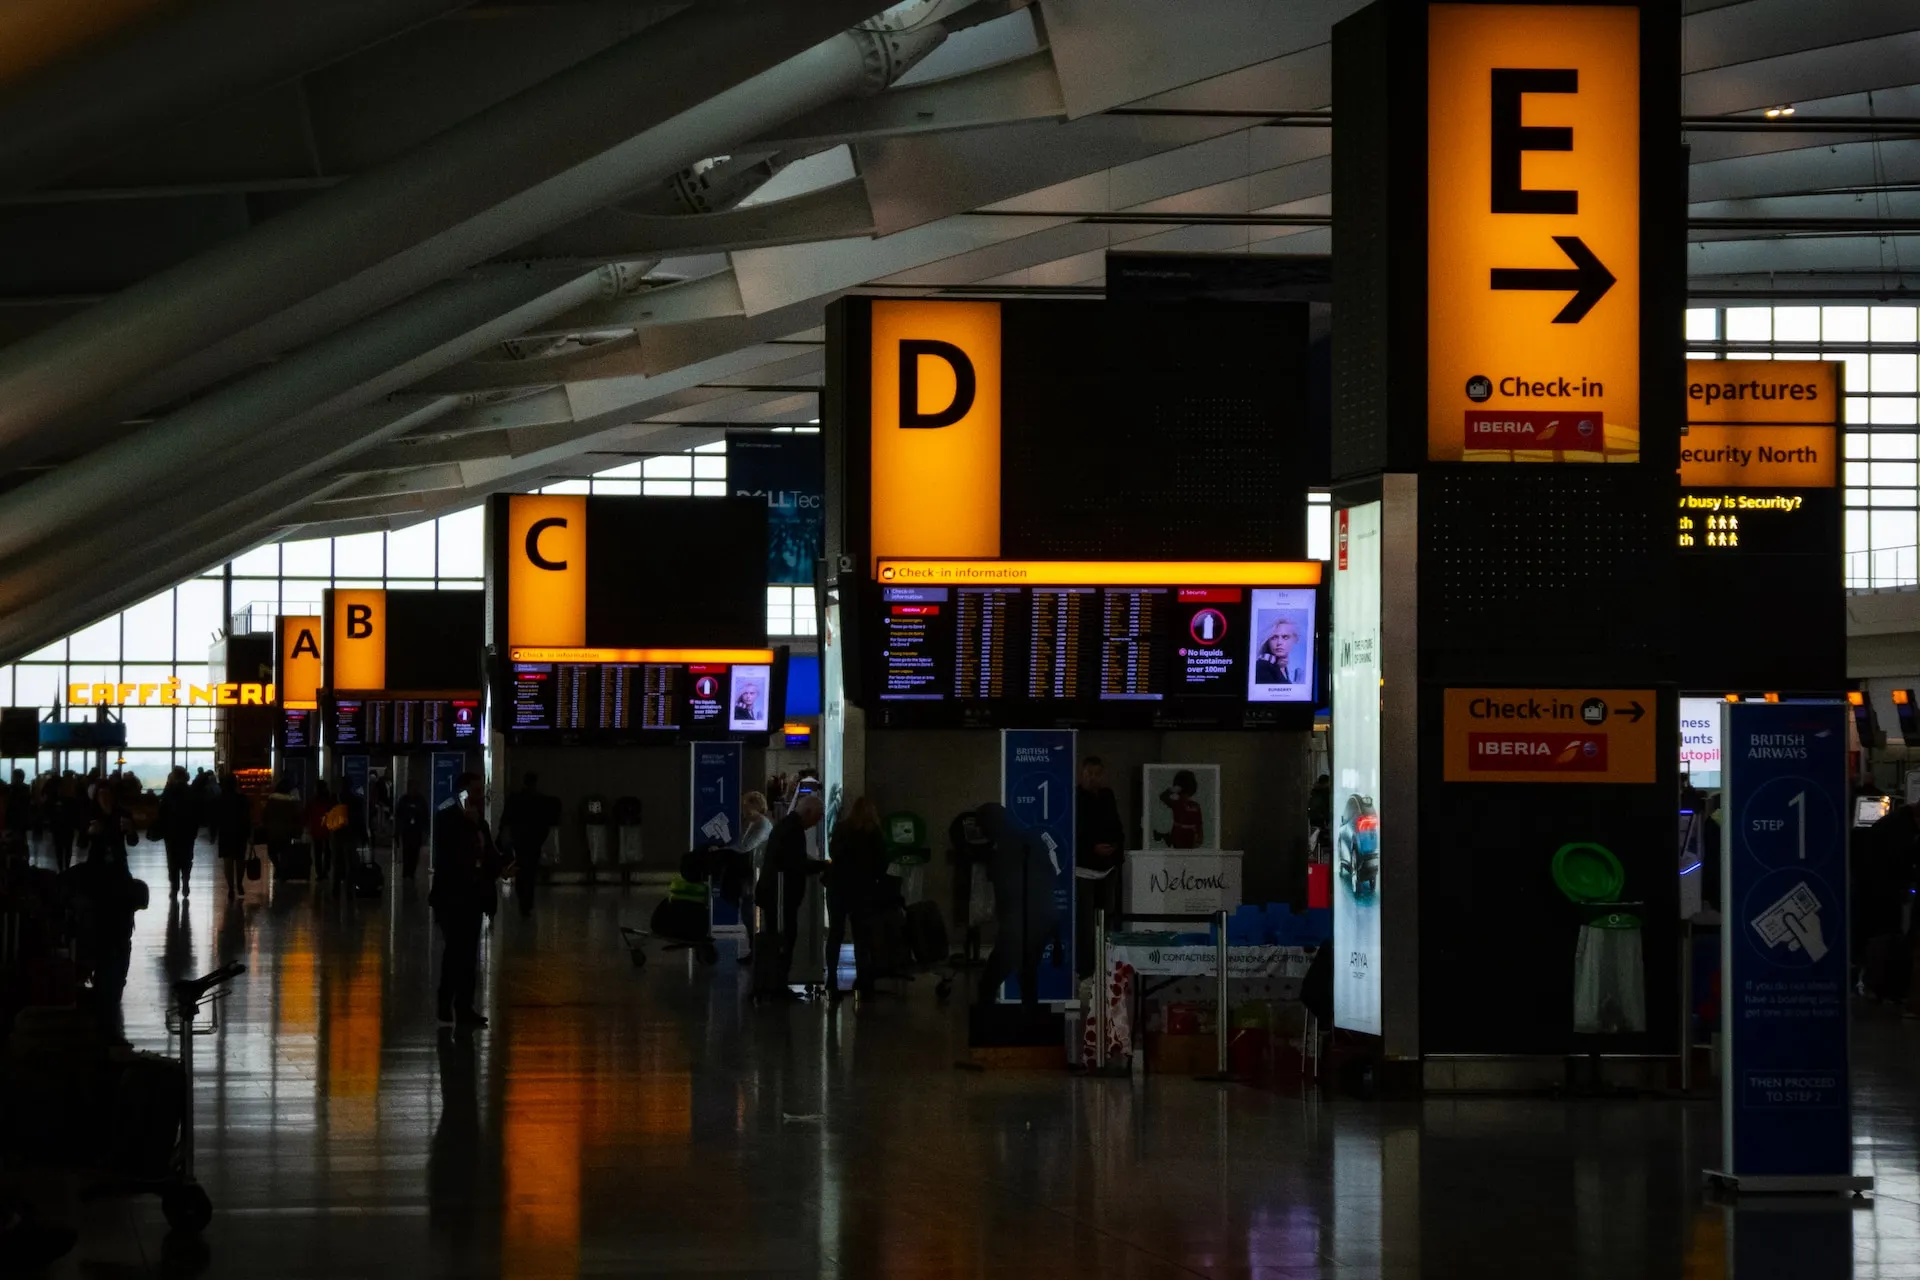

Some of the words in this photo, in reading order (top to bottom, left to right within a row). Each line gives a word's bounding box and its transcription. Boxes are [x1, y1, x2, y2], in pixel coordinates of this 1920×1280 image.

[1491, 68, 1578, 214] E
[899, 339, 976, 429] D
[1499, 376, 1604, 398] Check-in
[1688, 380, 1818, 404] epartures
[1473, 421, 1535, 433] IBERIA
[1681, 446, 1752, 466] ecurity
[1758, 446, 1817, 463] North
[789, 490, 821, 509] Tec
[1688, 495, 1721, 511] busy
[1724, 495, 1736, 508] is
[1738, 495, 1803, 511] Security?
[525, 518, 567, 571] C
[899, 567, 951, 578] Check-in
[955, 567, 1027, 578] information
[347, 604, 372, 638] B
[291, 629, 320, 659] A
[1187, 657, 1195, 665] in
[1196, 657, 1233, 665] containers
[1200, 649, 1223, 658] liquids
[1205, 665, 1226, 673] 100ml
[68, 676, 181, 705] CAFFÈ
[1468, 698, 1574, 719] Check-in
[1681, 719, 1711, 728] ness
[1682, 733, 1713, 744] unts
[1750, 733, 1805, 746] BRITISH
[1477, 741, 1552, 756] IBERIA
[1681, 749, 1719, 762] utopil
[1748, 747, 1808, 759] AIRWAYS
[1015, 755, 1050, 763] AIRWAYS
[716, 776, 724, 804] 1
[1017, 796, 1036, 804] STEP
[1037, 780, 1049, 820] 1
[1752, 819, 1785, 831] STEP
[1787, 790, 1806, 860] 1
[1162, 954, 1216, 963] CONTACTLESS
[1227, 954, 1265, 963] NATIONS
[1748, 1076, 1782, 1089] THEN
[1784, 1076, 1837, 1089] PROCEED
[1765, 1090, 1784, 1102] TO
[1785, 1090, 1812, 1102] STEP
